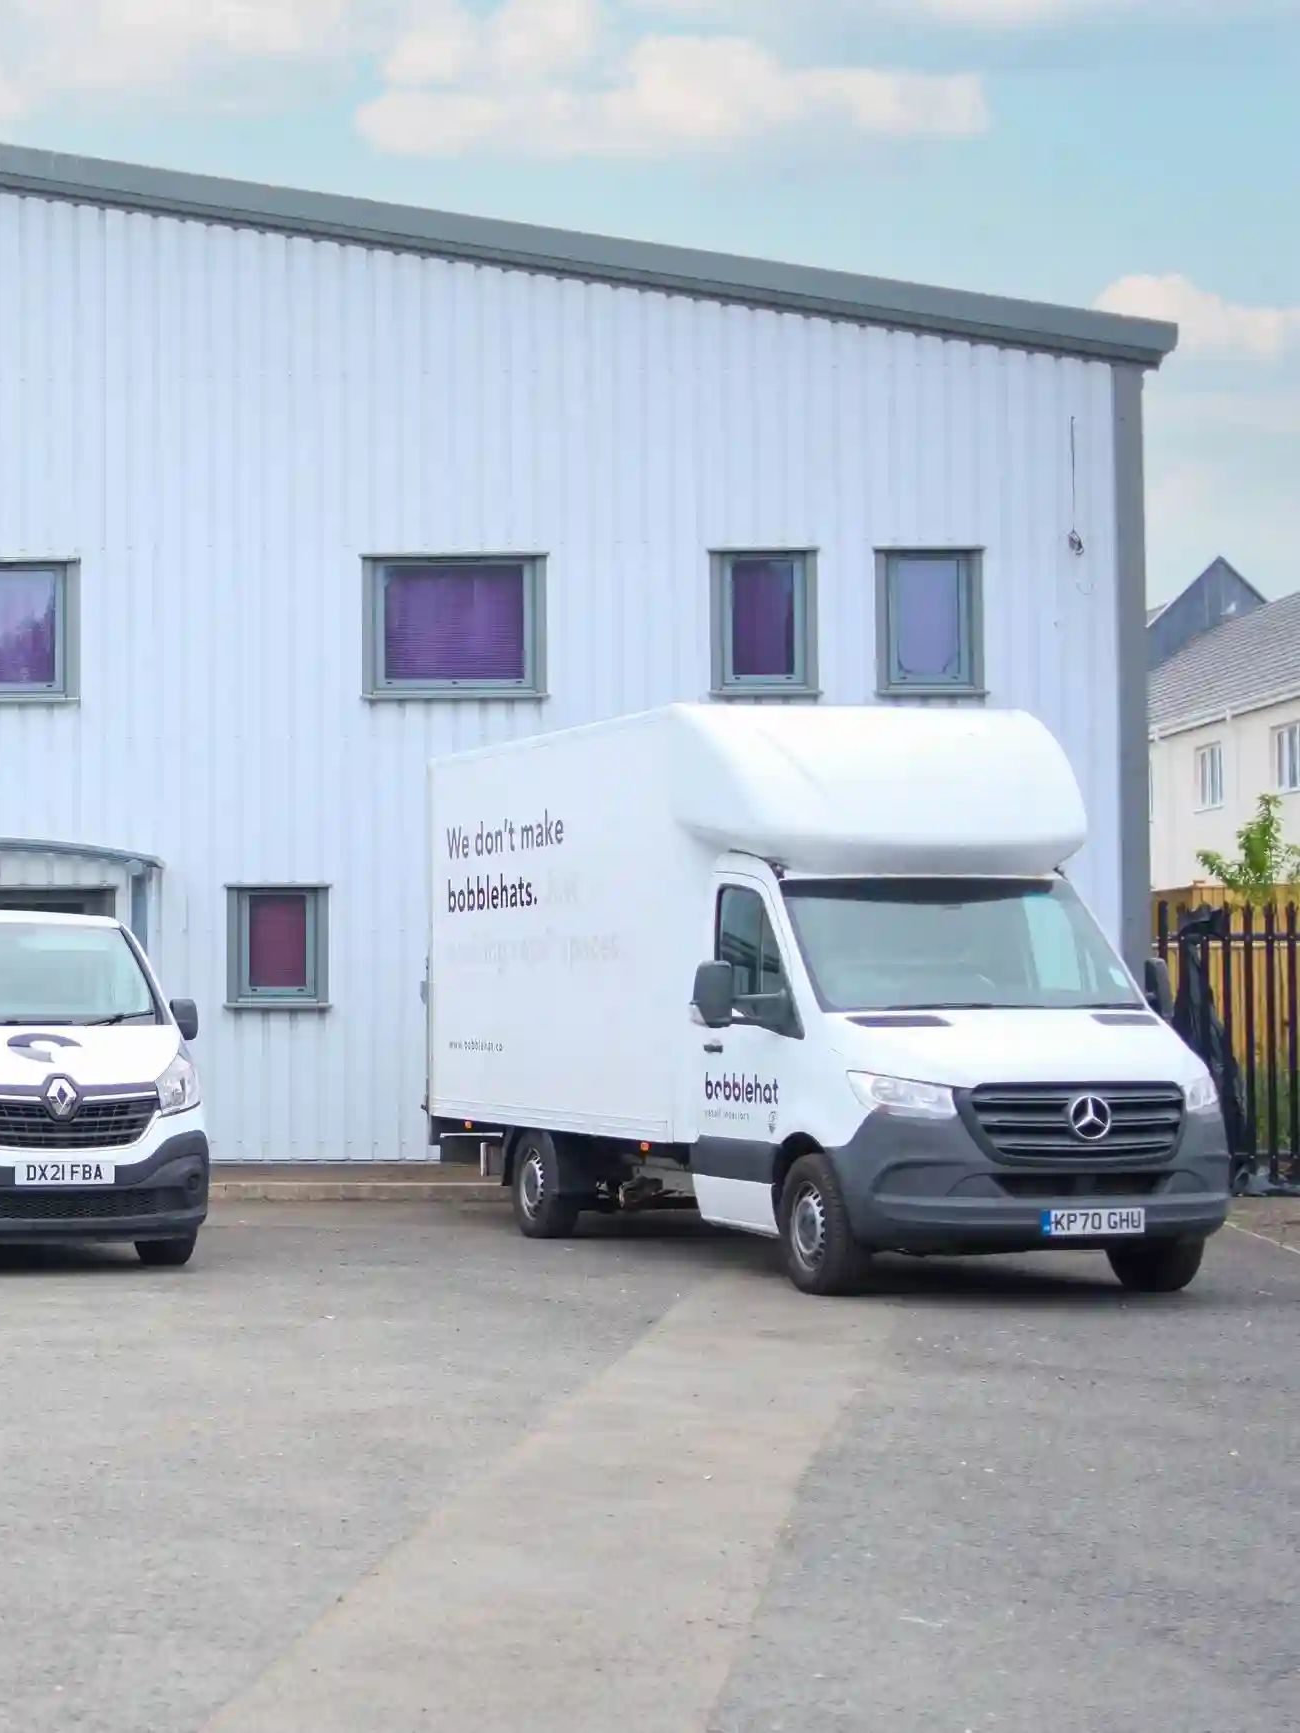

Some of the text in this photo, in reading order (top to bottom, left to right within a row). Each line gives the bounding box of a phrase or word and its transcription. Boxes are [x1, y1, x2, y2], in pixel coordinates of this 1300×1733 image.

[447, 808, 564, 859] We don't make
[448, 873, 538, 913] bobblehats.
[705, 1071, 779, 1105] bobblehat
[26, 1164, 103, 1181] DX21 FBA
[1054, 1211, 1141, 1231] KP70 GHU
